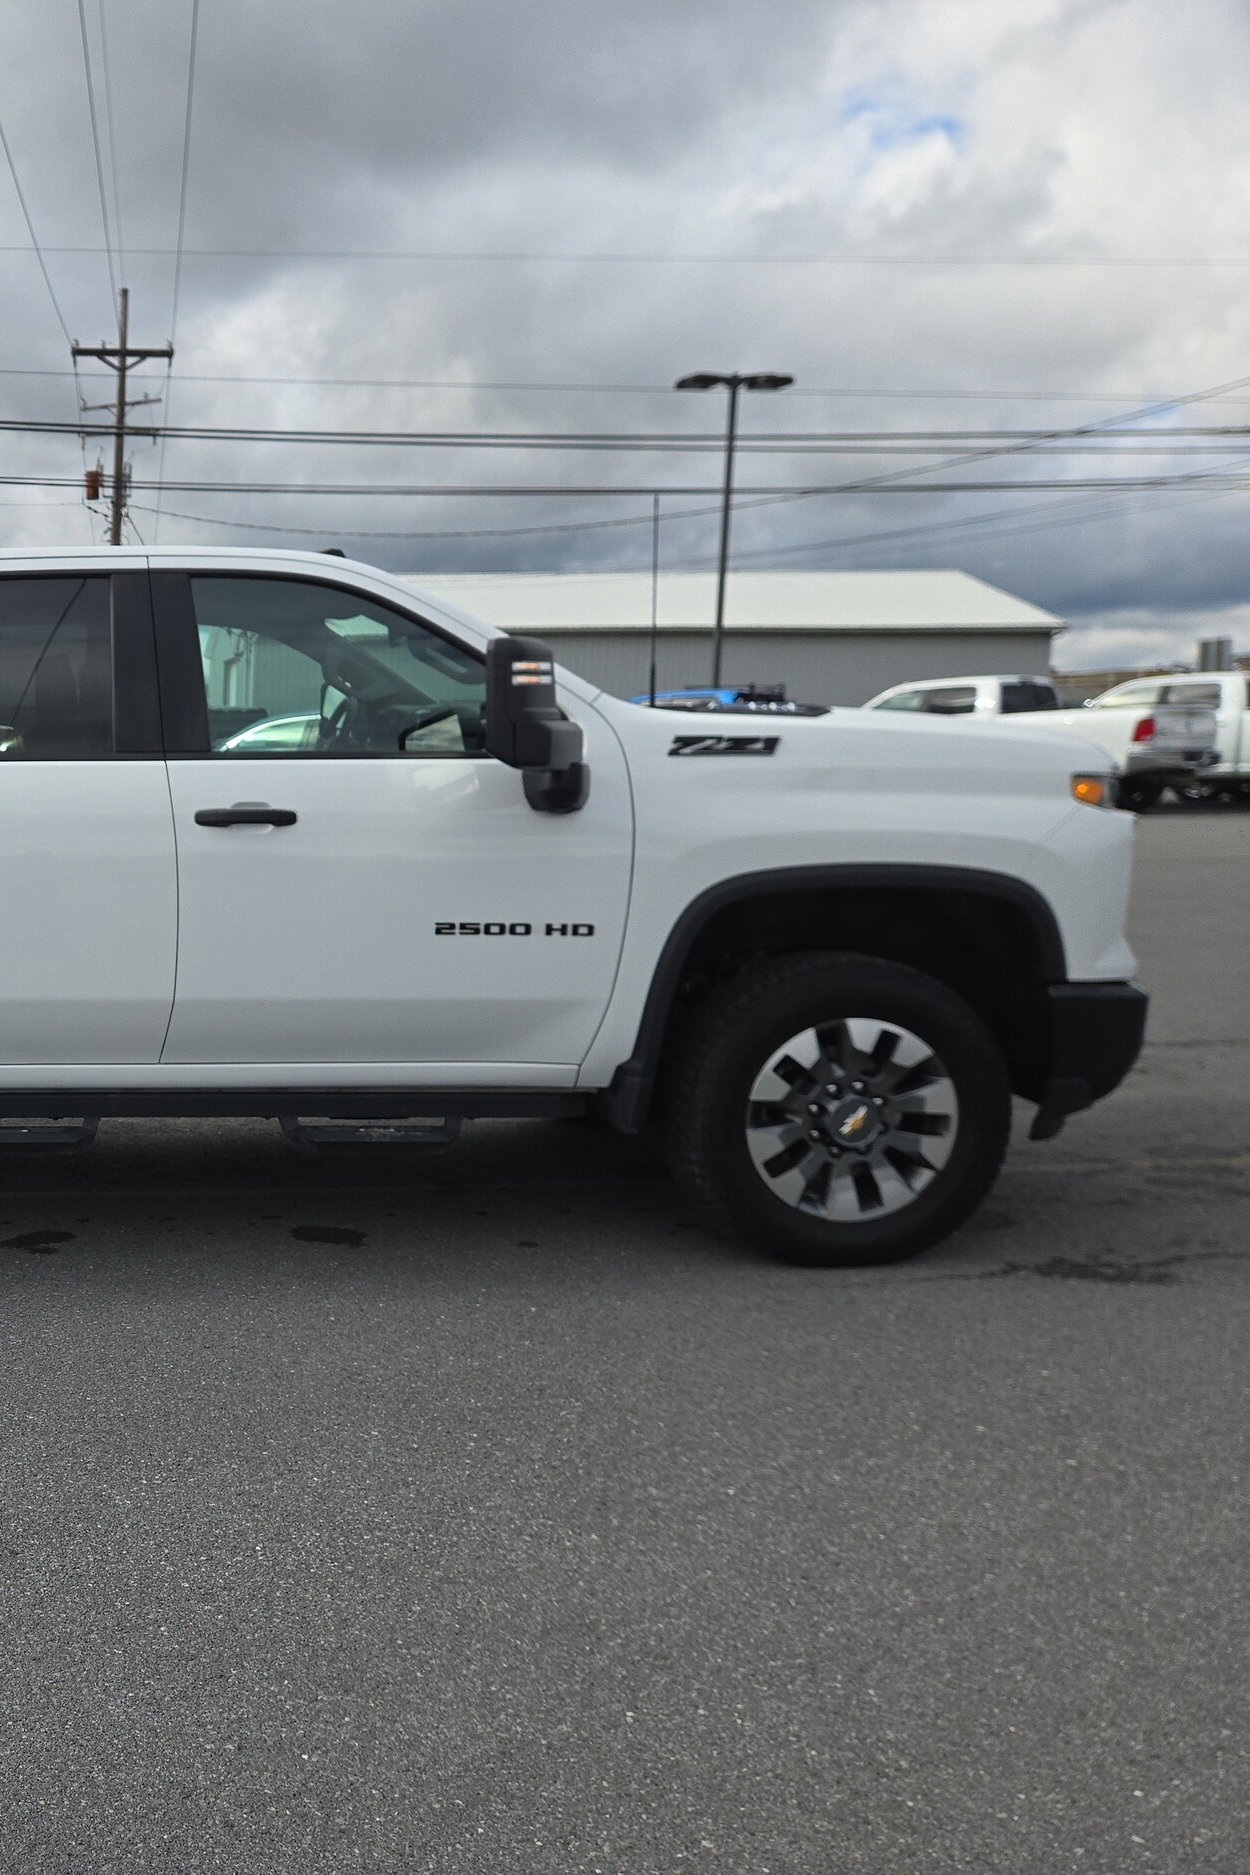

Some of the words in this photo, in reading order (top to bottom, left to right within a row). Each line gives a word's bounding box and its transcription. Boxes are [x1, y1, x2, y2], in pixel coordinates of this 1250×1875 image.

[667, 735, 781, 756] Z71
[434, 922, 532, 936] 2500
[544, 923, 595, 937] HD
